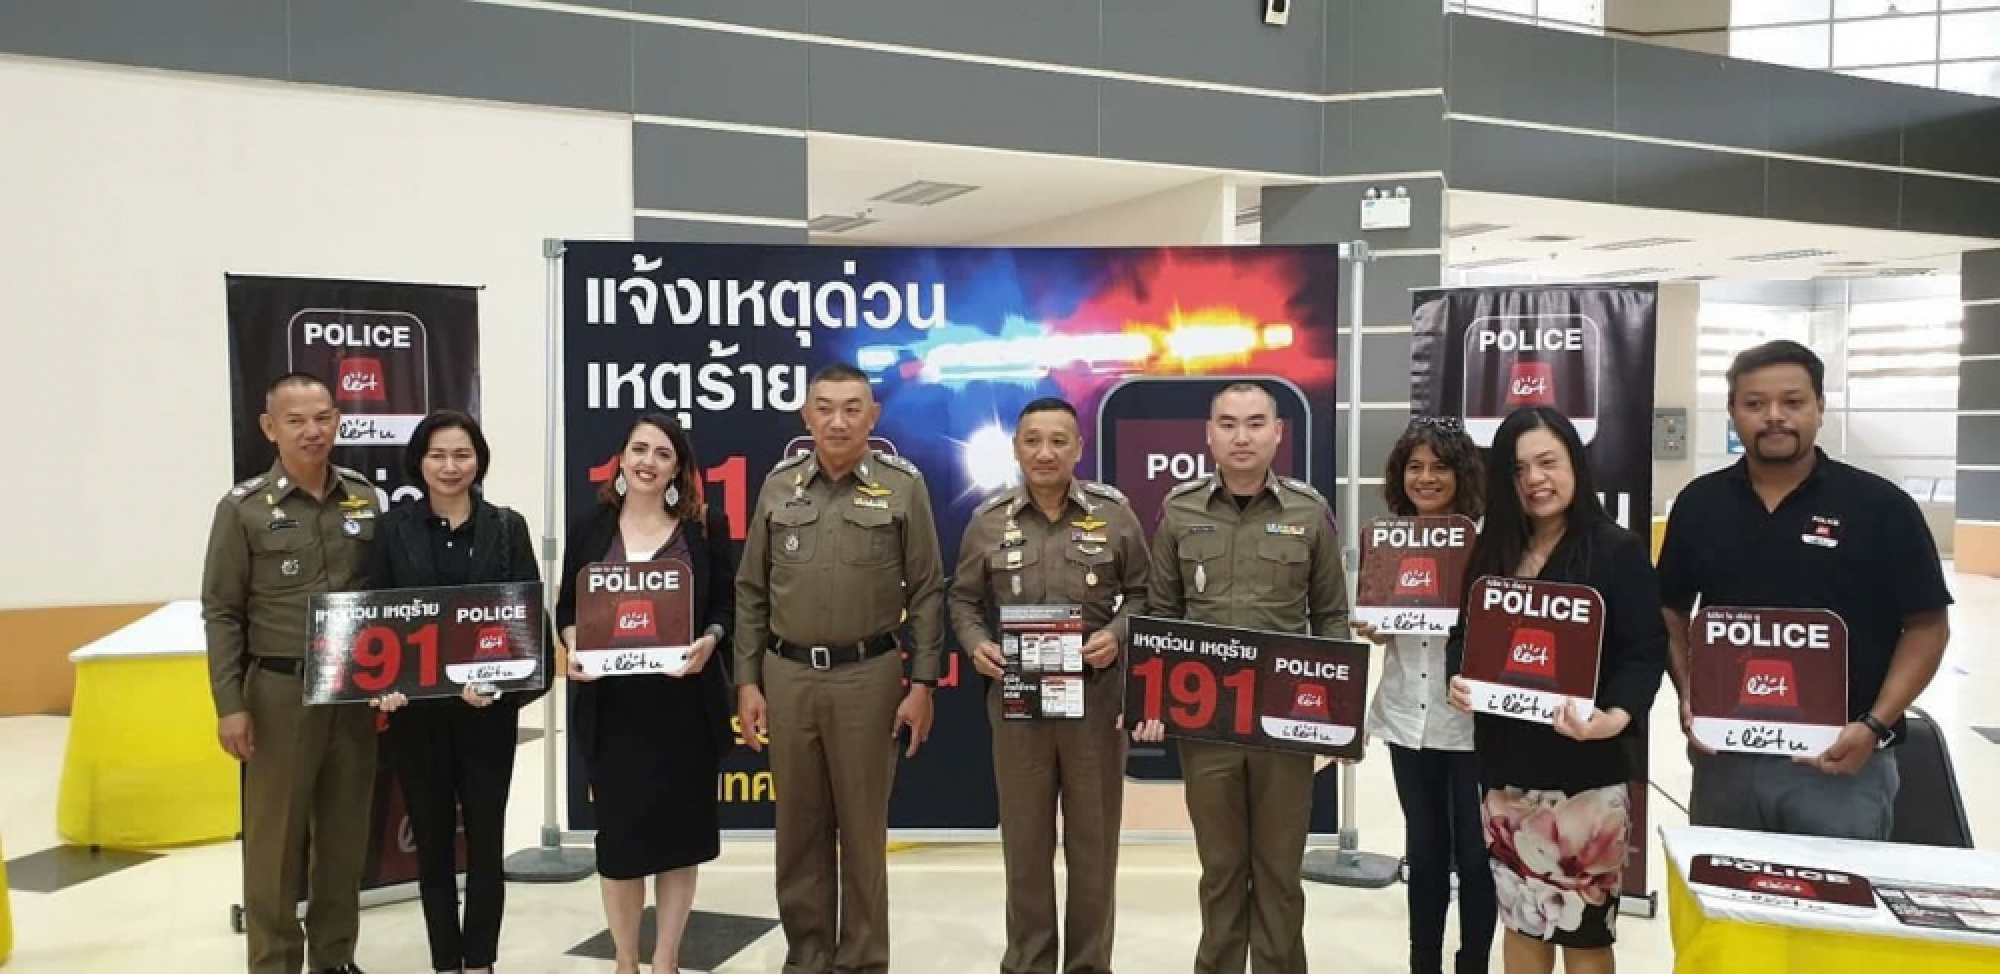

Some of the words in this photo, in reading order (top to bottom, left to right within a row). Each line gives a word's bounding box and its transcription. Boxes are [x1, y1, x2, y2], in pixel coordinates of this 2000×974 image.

[586, 253, 945, 348] แจ้งเหตุด่วน
[303, 323, 411, 348] POLICE
[1479, 329, 1583, 352] POLICE
[587, 340, 807, 430] เหตุร้าย
[1373, 527, 1465, 547] POLICE
[588, 569, 680, 593] POLICE
[456, 605, 527, 623] POLICE
[1483, 588, 1591, 623] POLICE
[1706, 621, 1830, 648] POLICE
[1275, 657, 1350, 681] POLICE
[1132, 657, 1256, 735] 191
